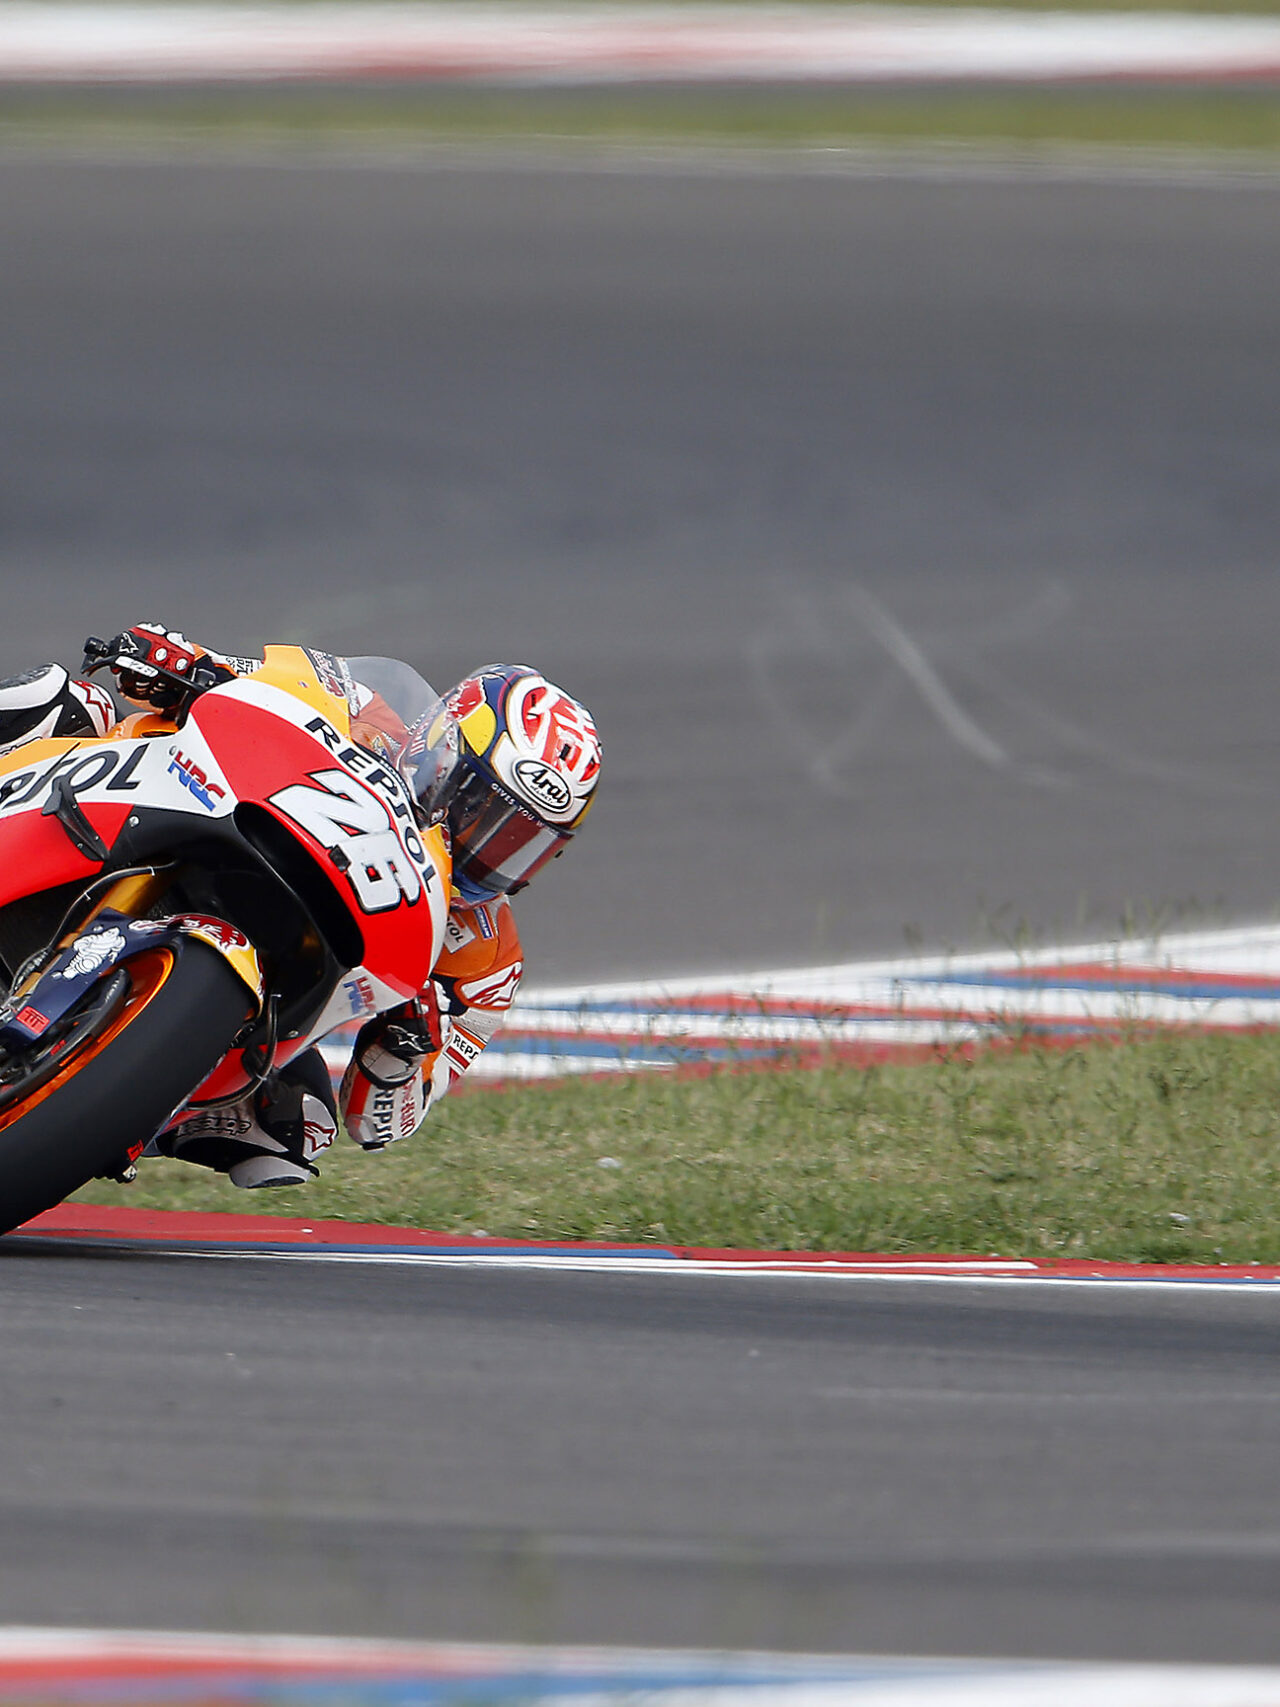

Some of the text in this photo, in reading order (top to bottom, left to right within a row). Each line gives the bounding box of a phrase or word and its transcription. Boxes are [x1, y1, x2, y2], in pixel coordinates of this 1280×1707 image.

[491, 782, 515, 805] GIVES
[519, 769, 568, 803] Arai
[304, 717, 436, 893] REPSOL
[267, 768, 421, 915] 26
[453, 1034, 478, 1060] REPS
